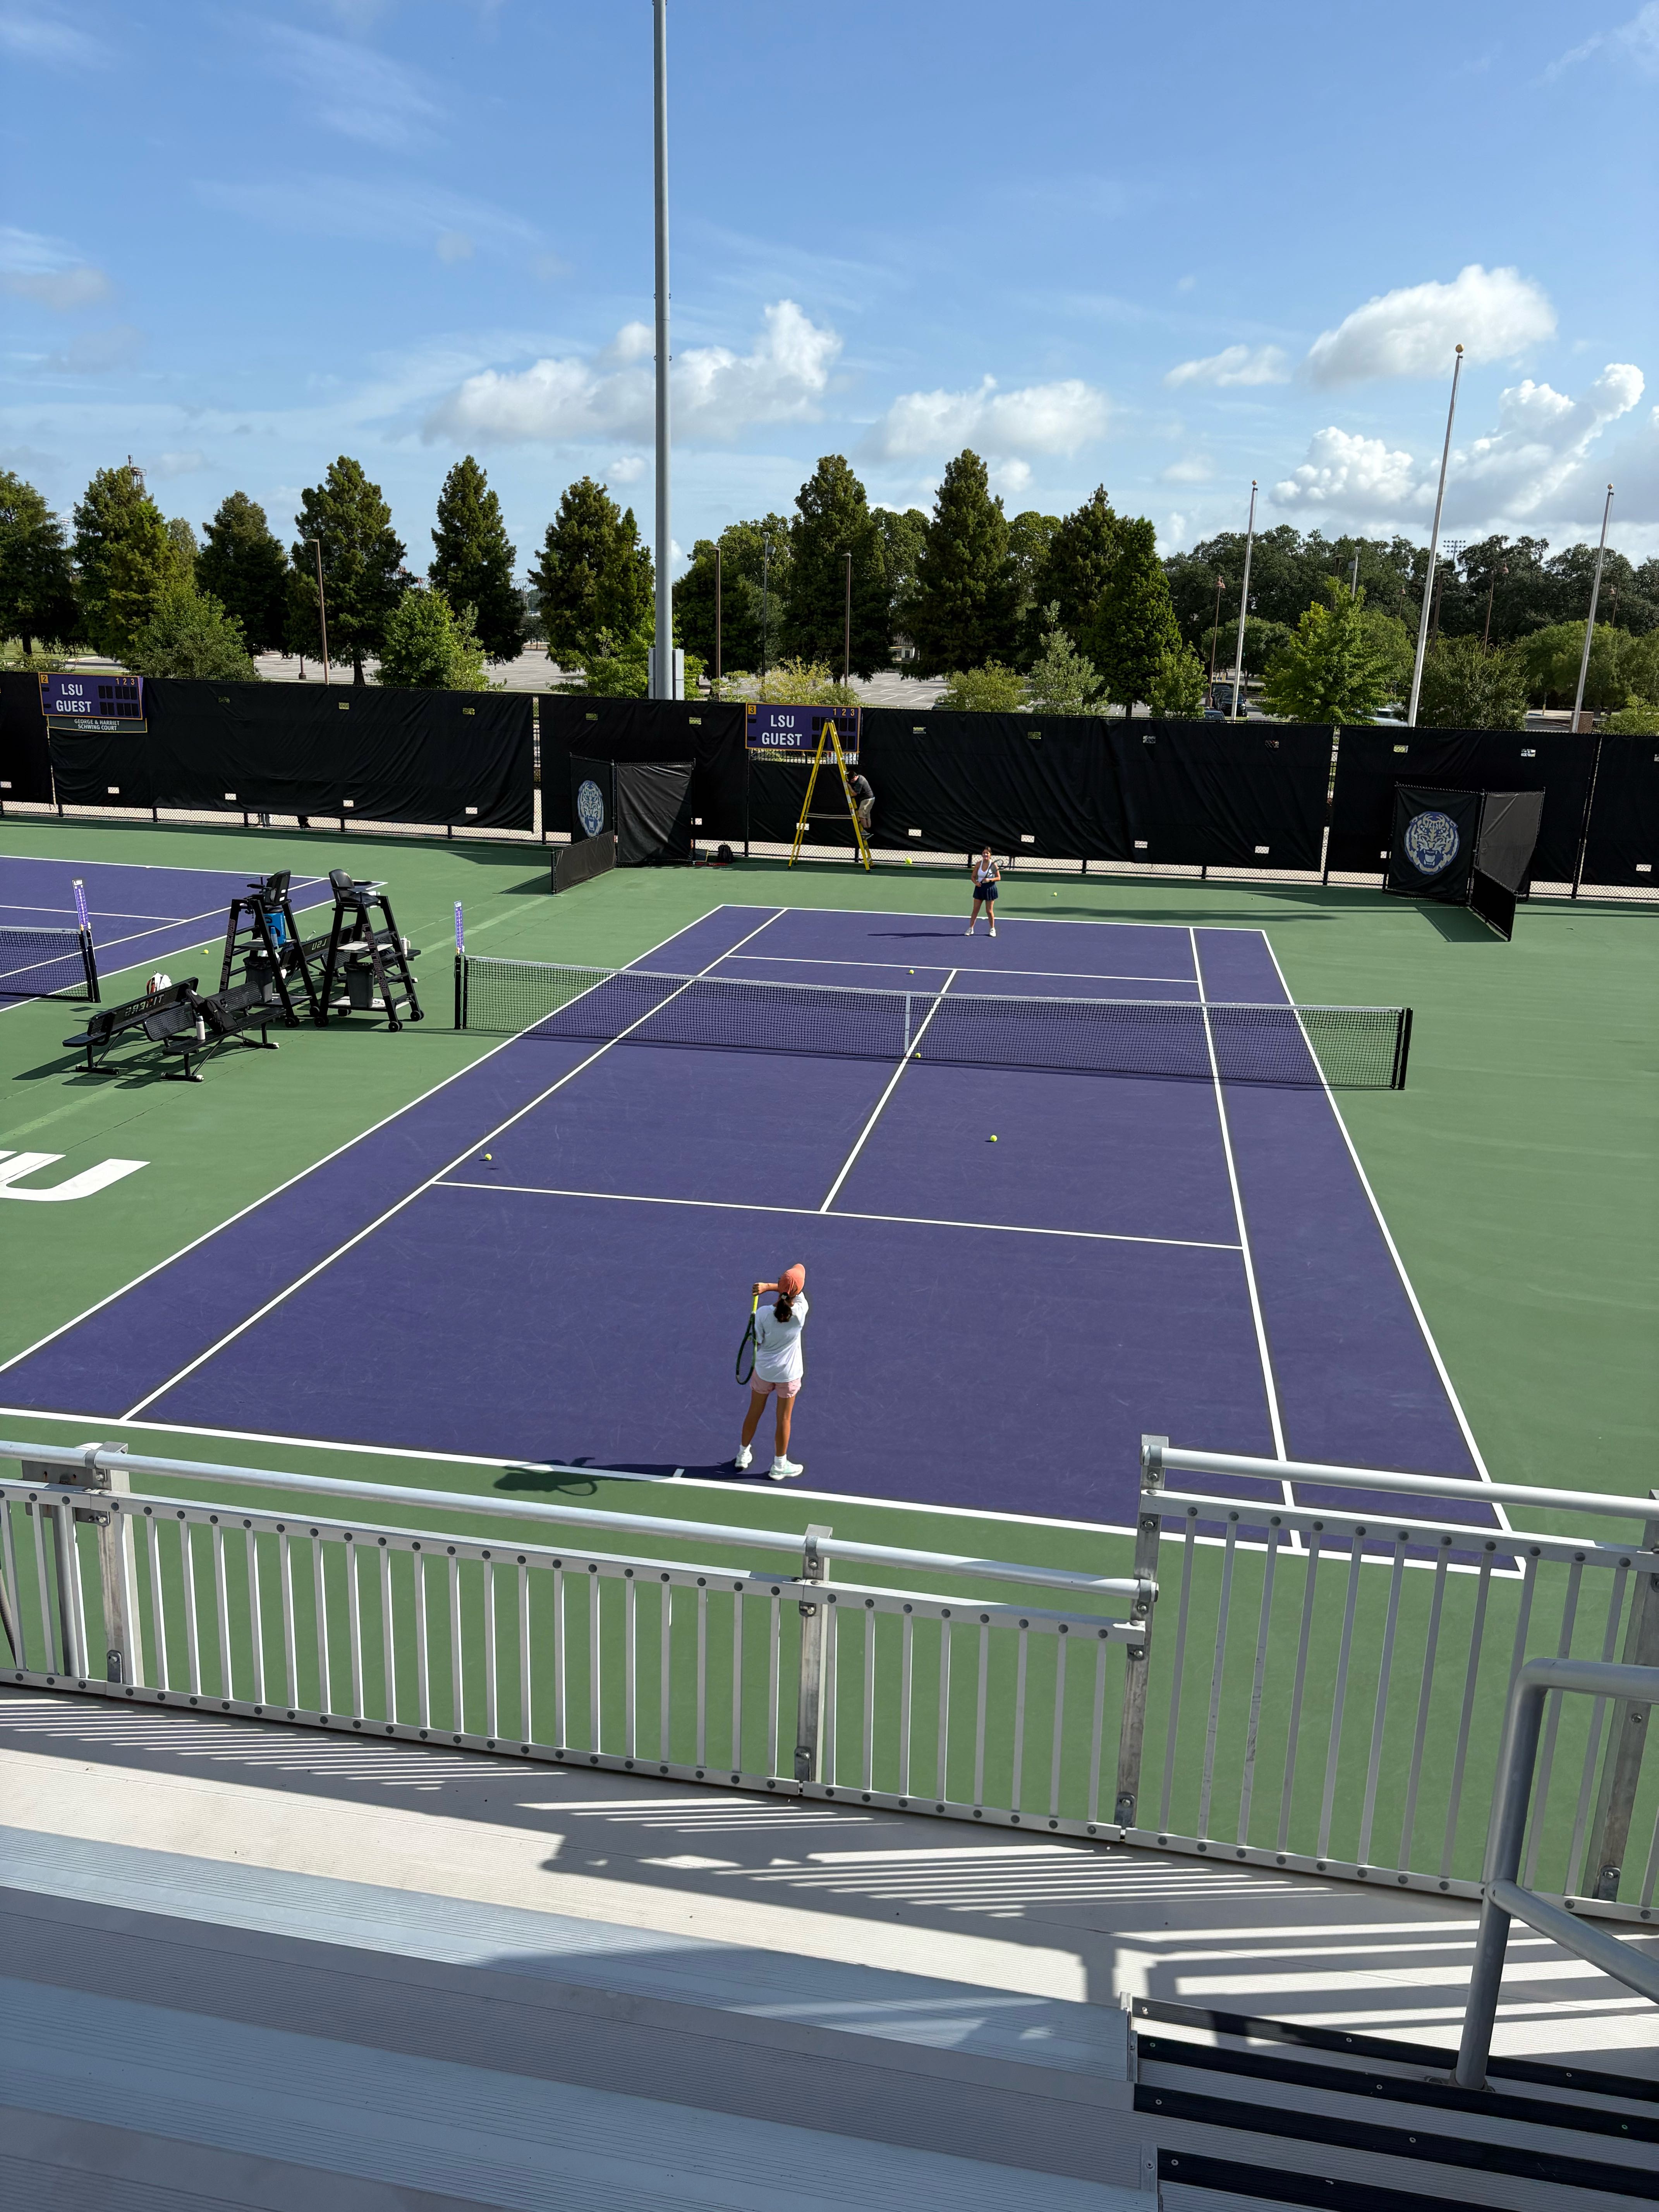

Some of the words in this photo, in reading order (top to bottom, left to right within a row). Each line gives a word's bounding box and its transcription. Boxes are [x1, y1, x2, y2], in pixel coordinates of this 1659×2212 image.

[61, 684, 83, 696] LSU
[56, 700, 91, 713] GUEST
[771, 715, 794, 728] LSU
[762, 732, 802, 746] GUEST
[223, 918, 236, 963] TIGERS
[362, 924, 376, 949] LSU
[371, 950, 390, 996] TIGERS
[220, 965, 229, 990] LSU
